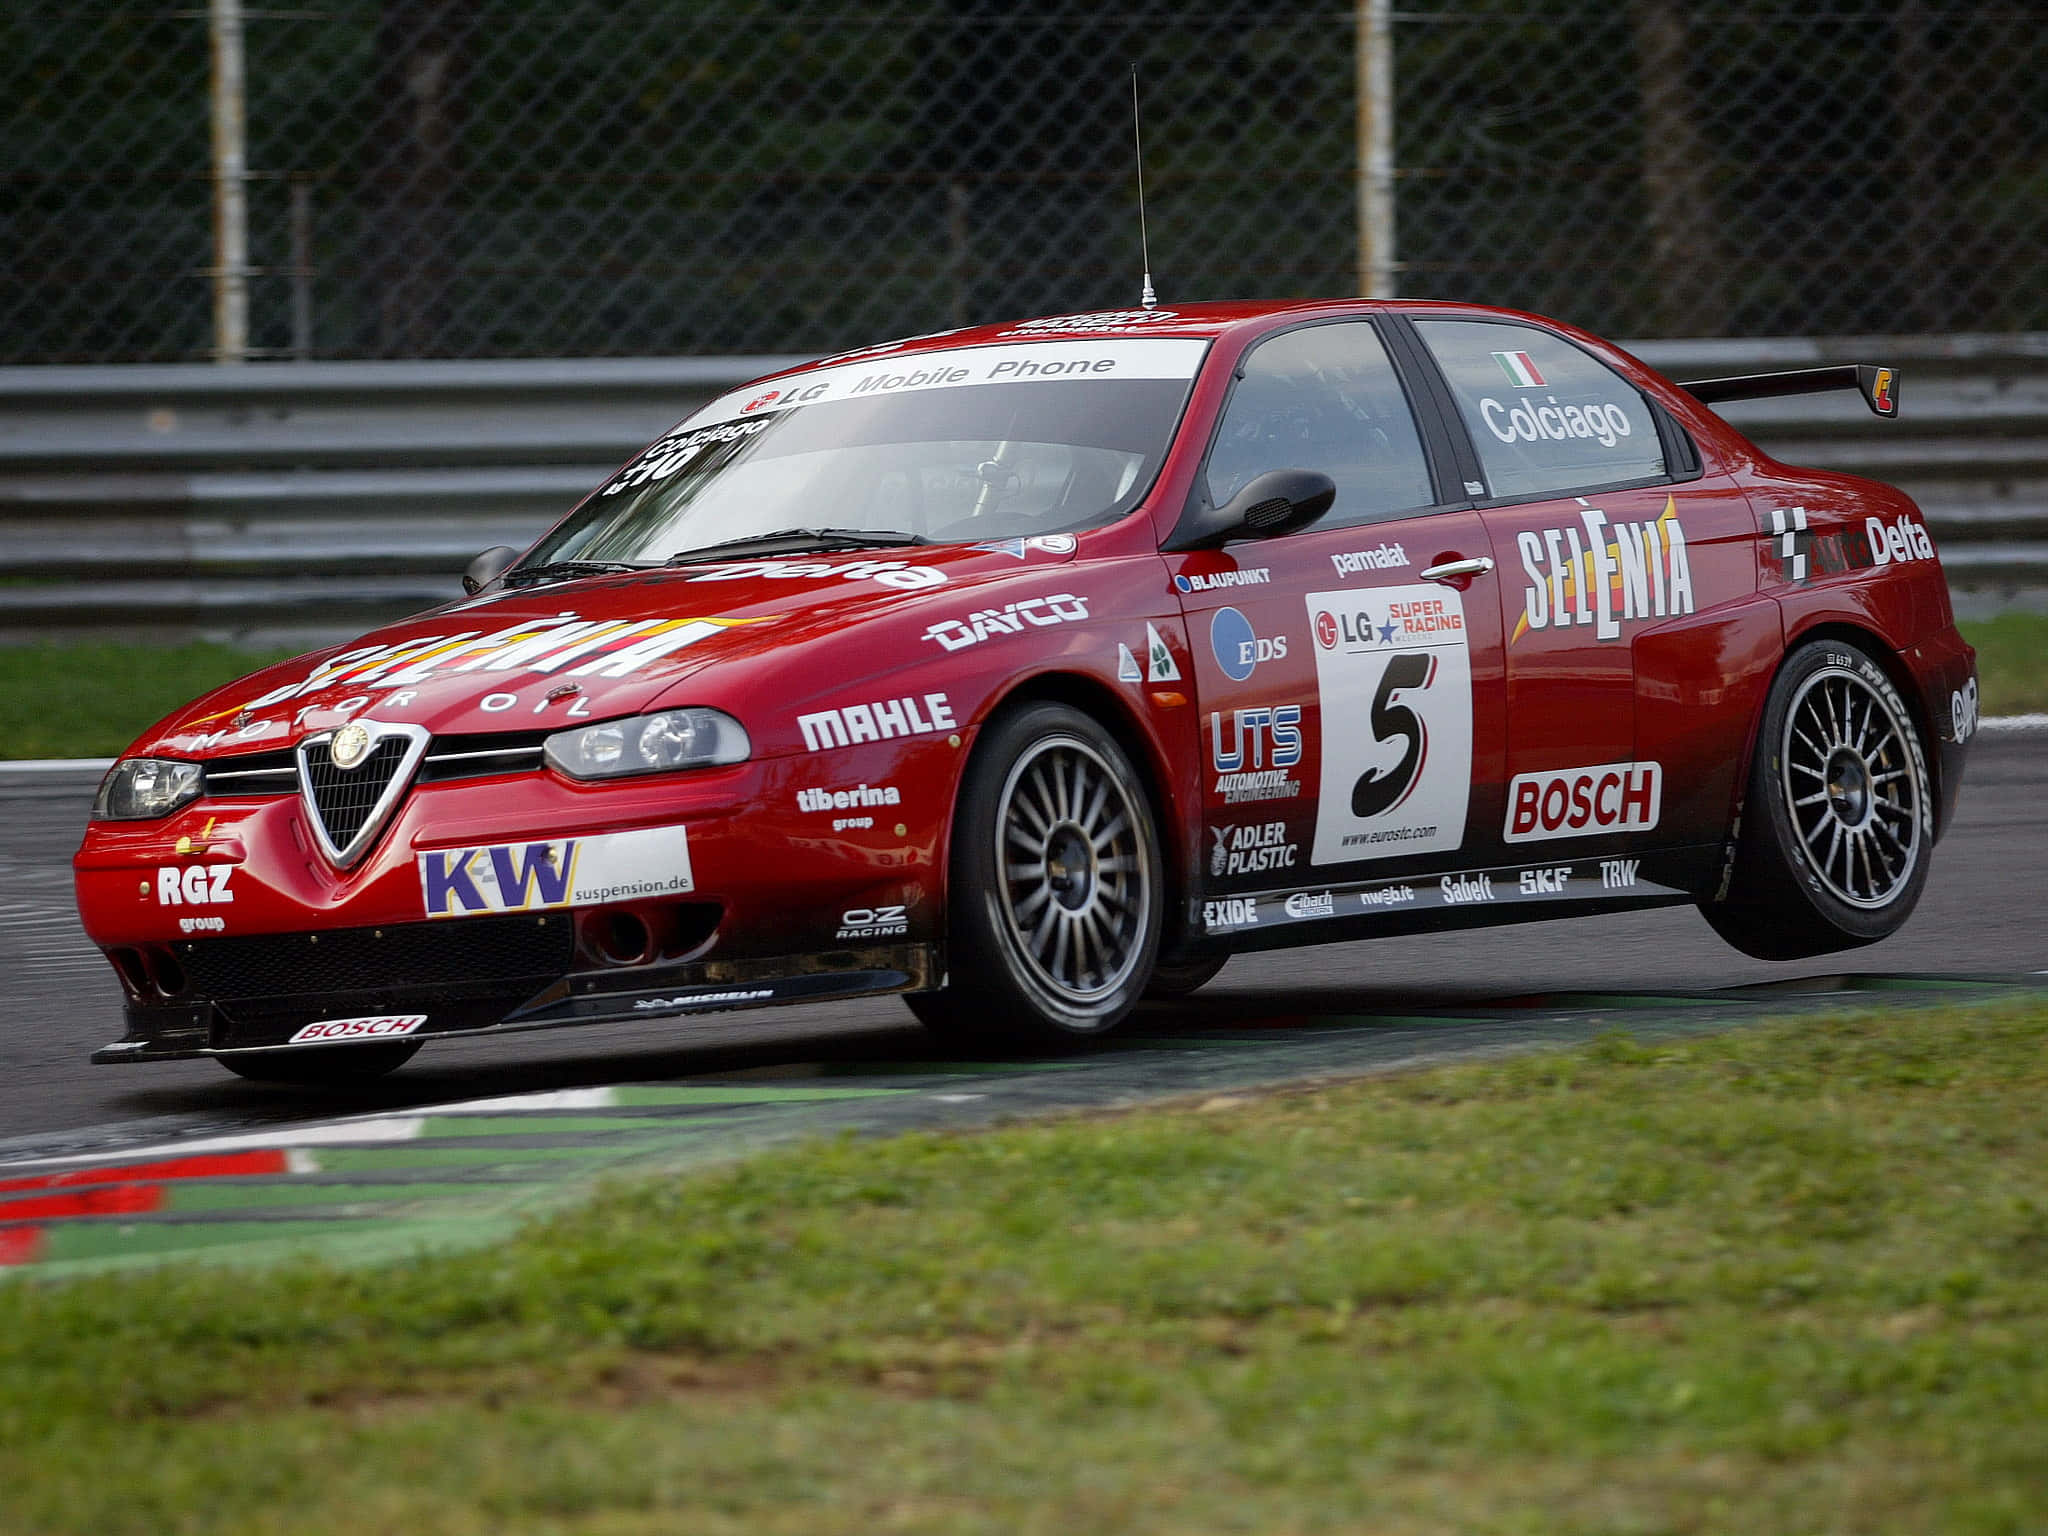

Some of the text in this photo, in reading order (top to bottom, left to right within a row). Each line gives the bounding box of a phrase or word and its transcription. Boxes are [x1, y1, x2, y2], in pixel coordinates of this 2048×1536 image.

[778, 358, 1116, 405] LG Mobile Phone
[1480, 396, 1631, 447] Colciago
[645, 419, 770, 460] Colciago
[686, 560, 948, 590] Delta
[1331, 543, 1410, 578] parmalat
[1190, 567, 1271, 591] BLAUPUNKT
[921, 593, 1089, 652] DAYCO
[1389, 600, 1443, 618] SUPER
[1403, 614, 1462, 633] RACING
[1340, 612, 1373, 642] LG
[1238, 635, 1288, 665] EDS
[185, 690, 412, 753] MOTOR
[479, 692, 591, 719] OIL
[797, 693, 957, 753] MAHLE
[1351, 653, 1438, 818] 5
[1211, 704, 1303, 773] UTS
[1214, 769, 1289, 793] AUTOMOTIVE
[797, 784, 901, 814] tiberina
[1511, 769, 1654, 836] BOSCH
[833, 816, 874, 831] group
[1231, 822, 1286, 850] ADLER
[1341, 824, 1438, 847] www.eurostc.com
[1227, 844, 1298, 875] PLASTIC
[1600, 860, 1641, 889] TRW
[157, 864, 234, 906] RGZ
[425, 840, 690, 917] KW suspension.de
[1440, 873, 1496, 904] Sabelt
[1520, 867, 1573, 896] SKF
[179, 916, 225, 933] group
[1203, 898, 1259, 927] EXIDE
[836, 924, 907, 939] RACING
[299, 1017, 416, 1040] BOSCH
